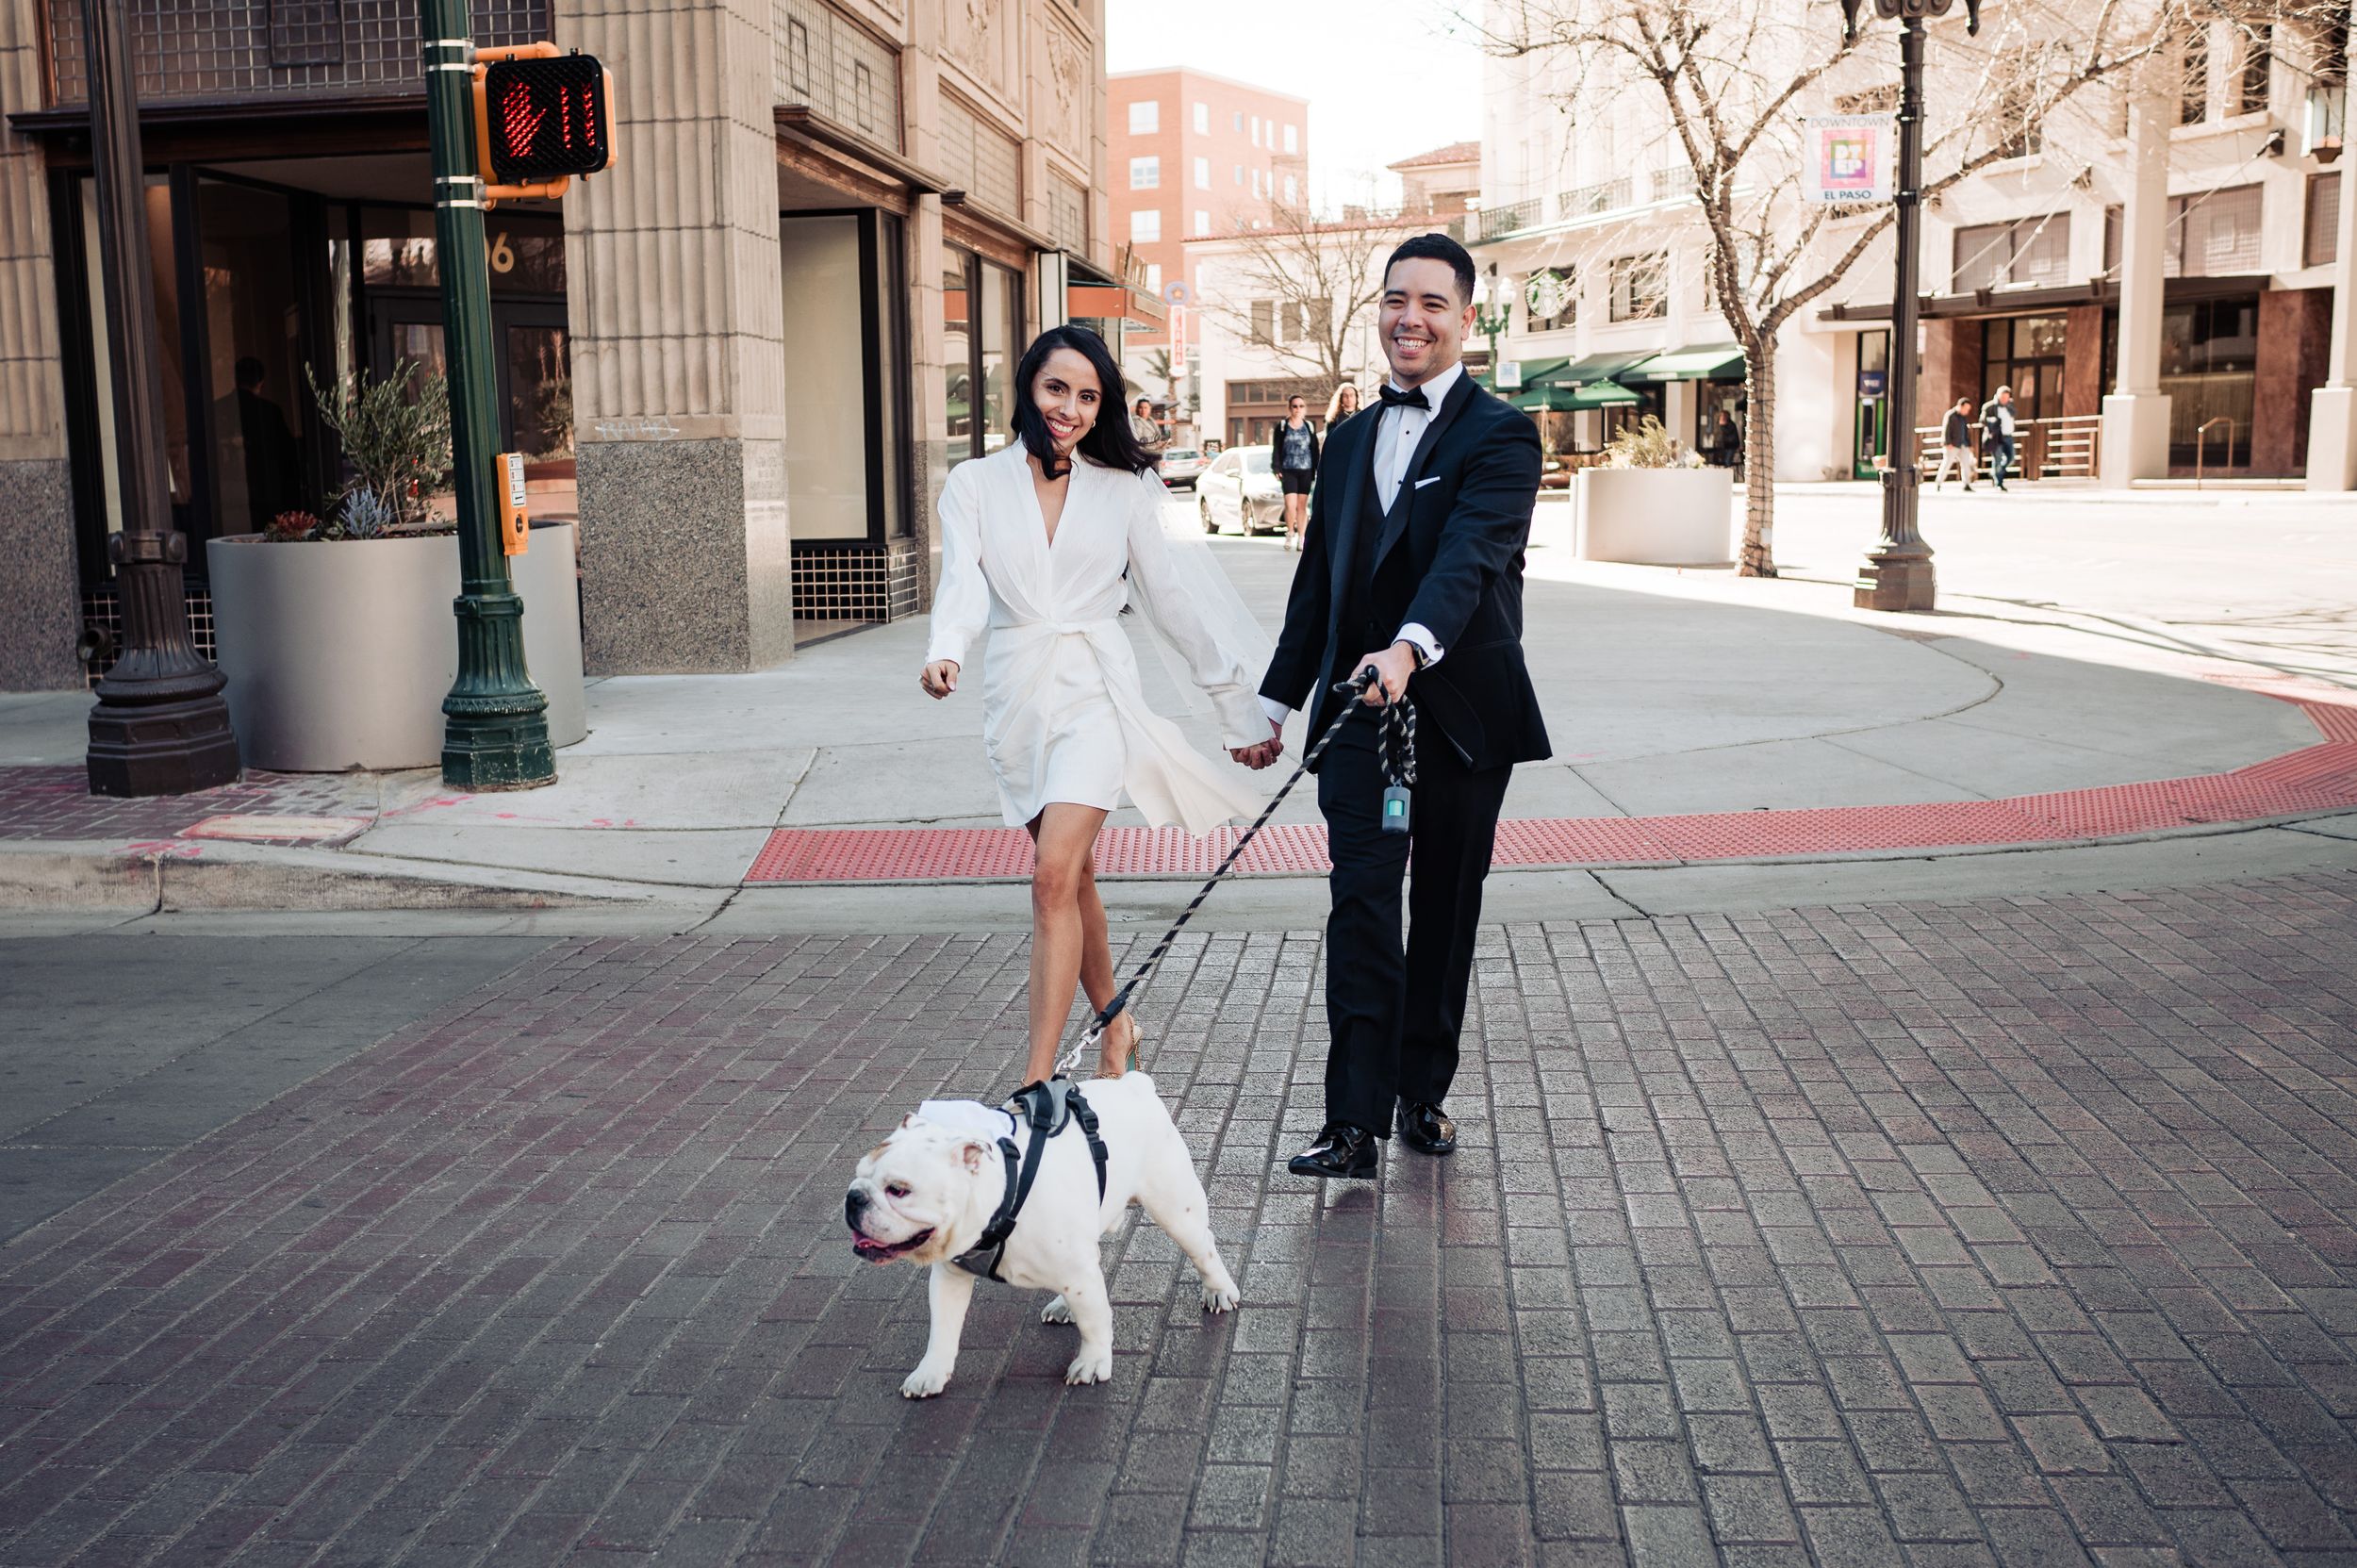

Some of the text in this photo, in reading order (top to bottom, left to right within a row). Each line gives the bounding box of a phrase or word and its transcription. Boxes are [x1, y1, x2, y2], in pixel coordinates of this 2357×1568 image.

[560, 83, 596, 149] 11
[1810, 118, 1889, 128] DOWNTOWN
[1824, 190, 1871, 200] EL PASO
[485, 232, 515, 273] 6
